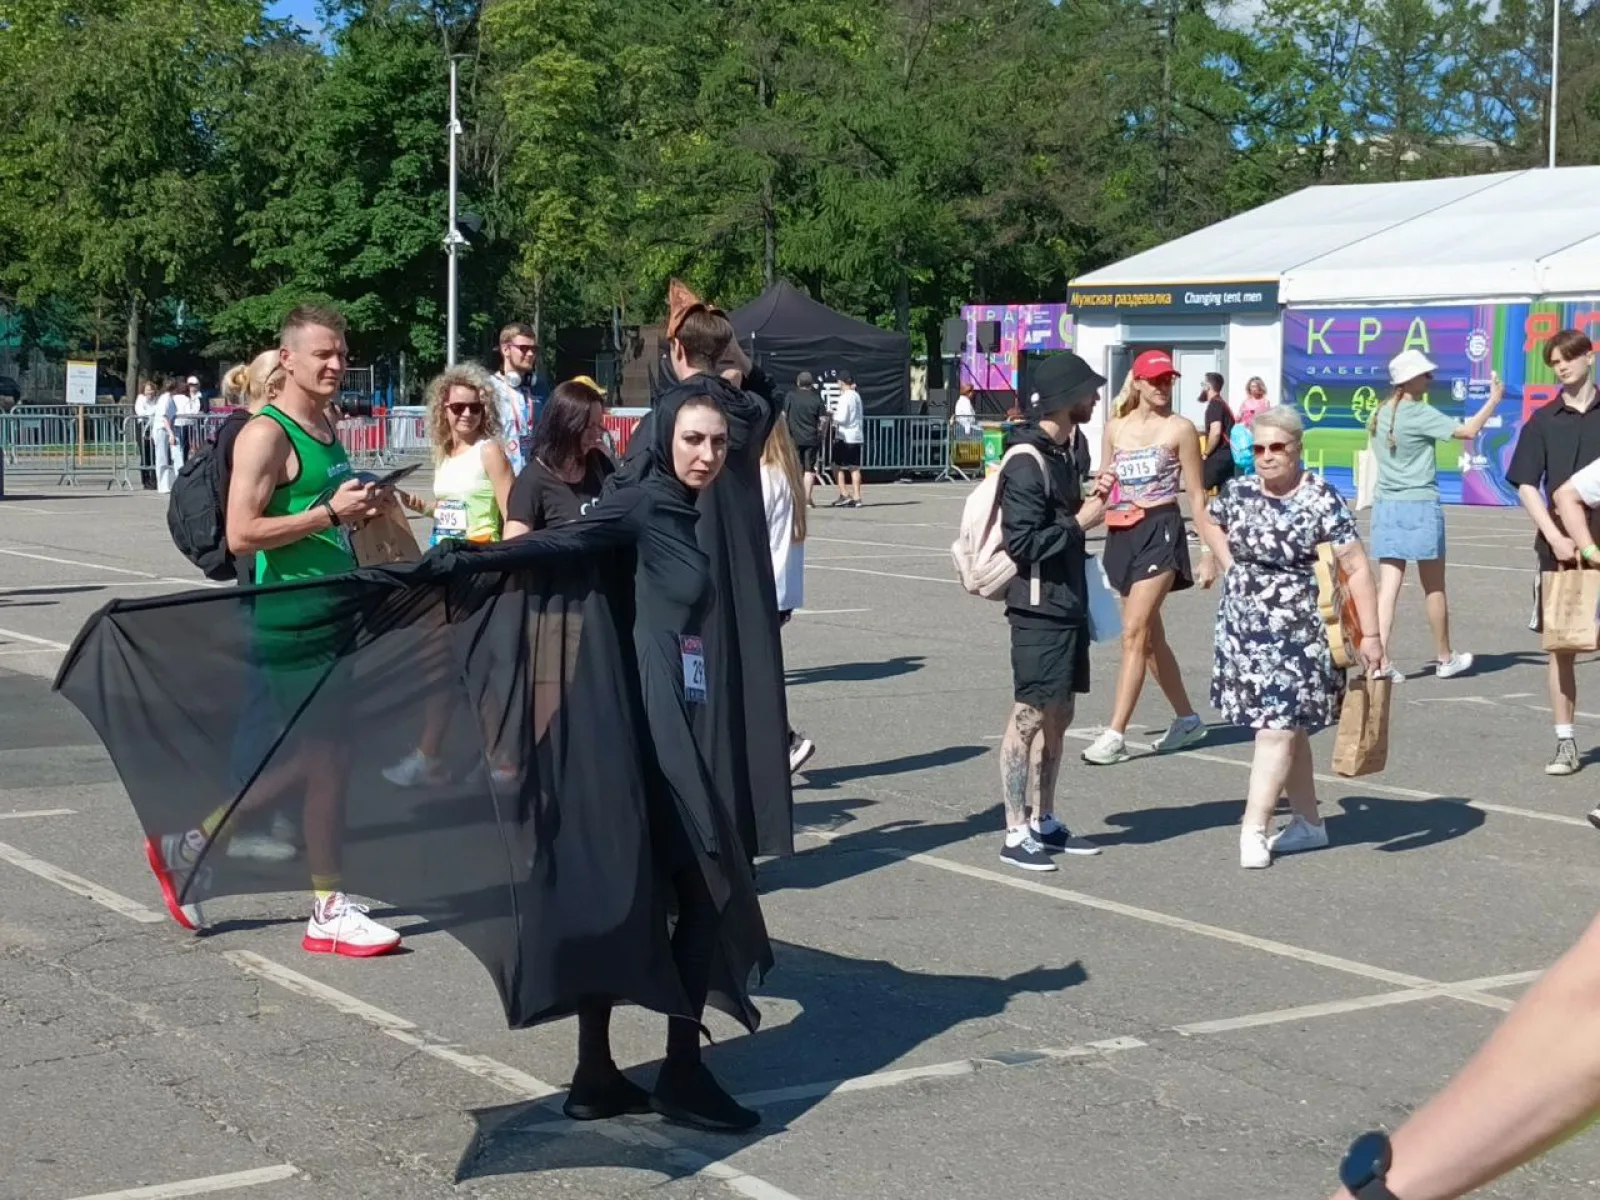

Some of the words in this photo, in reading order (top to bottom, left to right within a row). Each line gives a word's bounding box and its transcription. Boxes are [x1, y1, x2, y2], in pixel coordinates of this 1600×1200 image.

[1071, 292, 1112, 308] Мужская
[1115, 293, 1172, 308] раздевалка
[1184, 292, 1221, 306] Changing
[1223, 292, 1241, 303] tent
[1243, 293, 1262, 302] men
[1306, 316, 1430, 355] КРА
[1306, 366, 1380, 375] ЗАБЕГ
[1119, 461, 1151, 477] 3915
